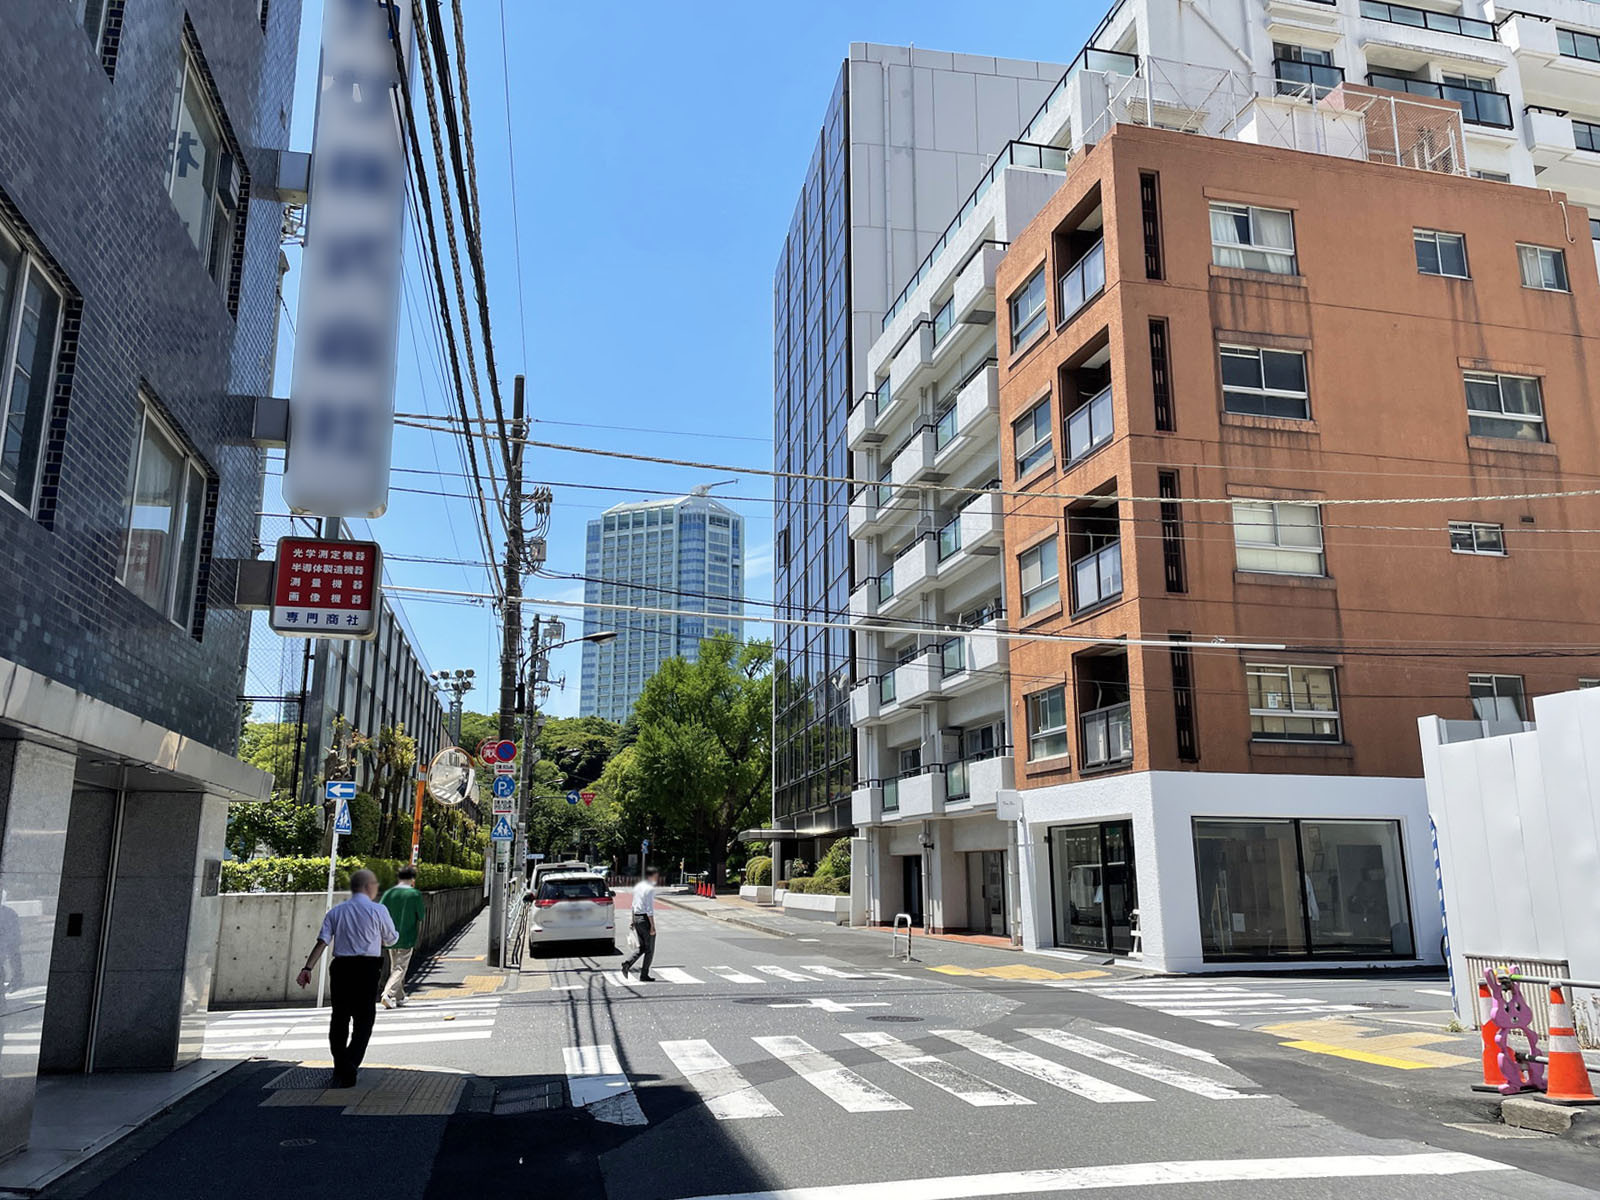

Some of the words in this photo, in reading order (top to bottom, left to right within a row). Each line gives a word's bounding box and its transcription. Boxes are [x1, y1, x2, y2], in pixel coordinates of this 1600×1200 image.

[293, 548, 365, 561] 光学測定機器
[291, 563, 364, 576] 半導体製造機器
[286, 611, 359, 626] 専門商社
[498, 781, 507, 796] P
